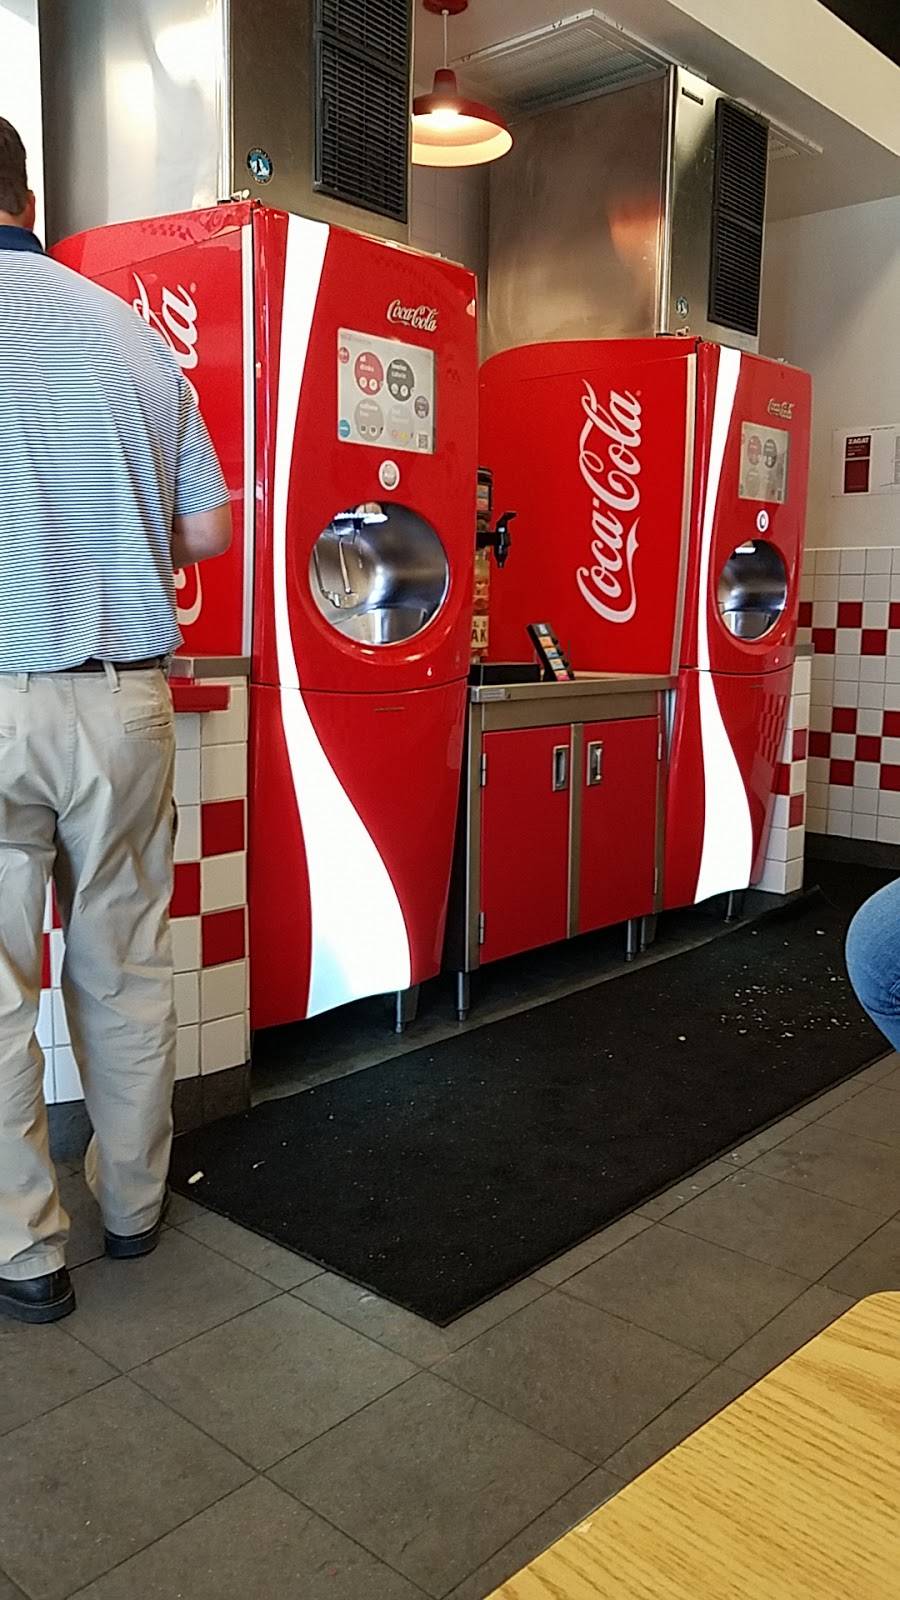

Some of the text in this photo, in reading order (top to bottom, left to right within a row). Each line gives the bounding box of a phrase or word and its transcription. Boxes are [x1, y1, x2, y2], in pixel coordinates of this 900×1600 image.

[387, 299, 438, 332] Coca-Cola
[847, 437, 869, 445] ZAGAT
[577, 378, 642, 623] Coca-Cola
